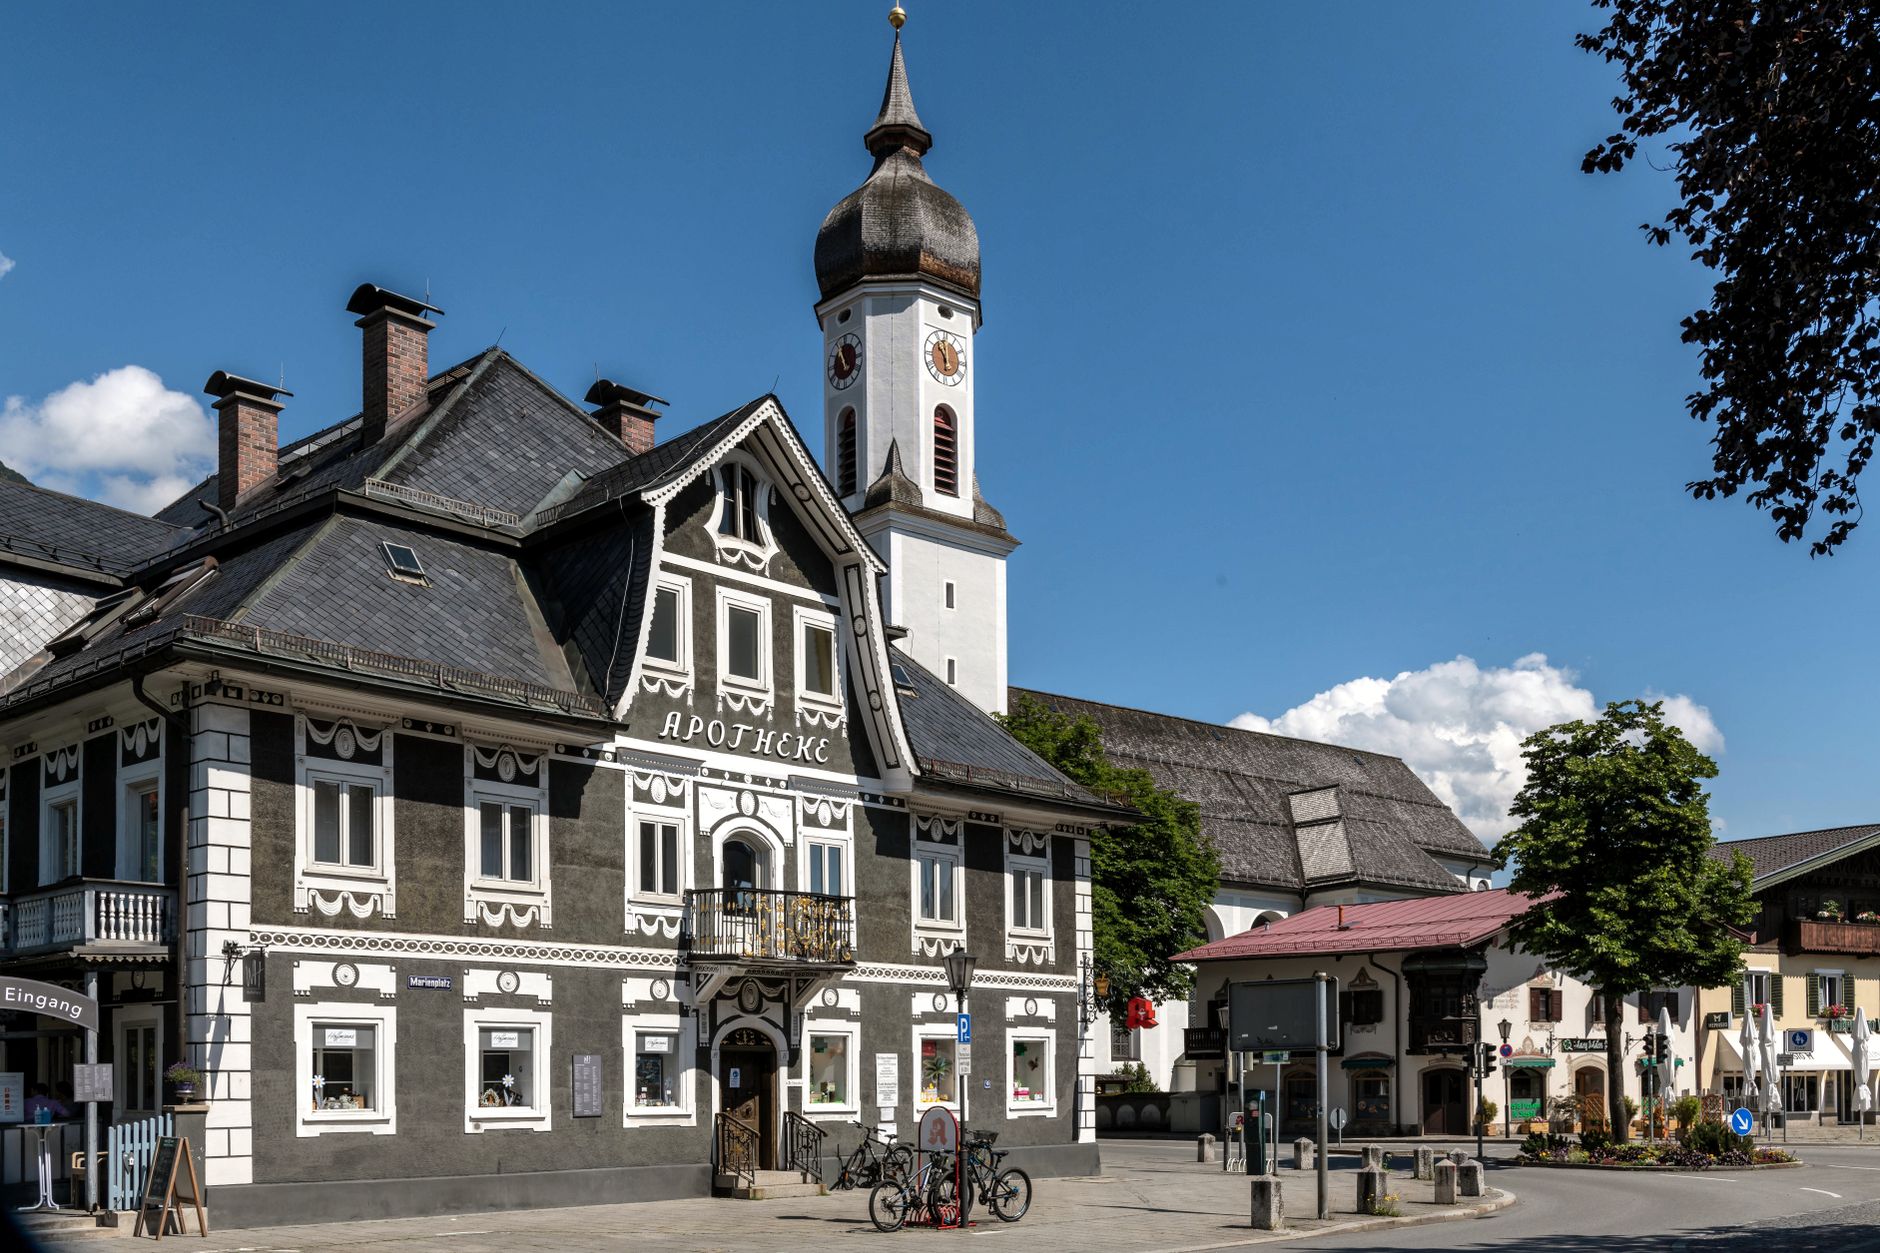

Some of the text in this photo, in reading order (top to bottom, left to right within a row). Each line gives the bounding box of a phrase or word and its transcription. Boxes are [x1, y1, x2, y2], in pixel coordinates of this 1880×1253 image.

[658, 711, 830, 764] APOTHEKE
[410, 977, 450, 989] Marienplatz
[5, 987, 83, 1019] Eingang
[960, 1017, 968, 1041] P
